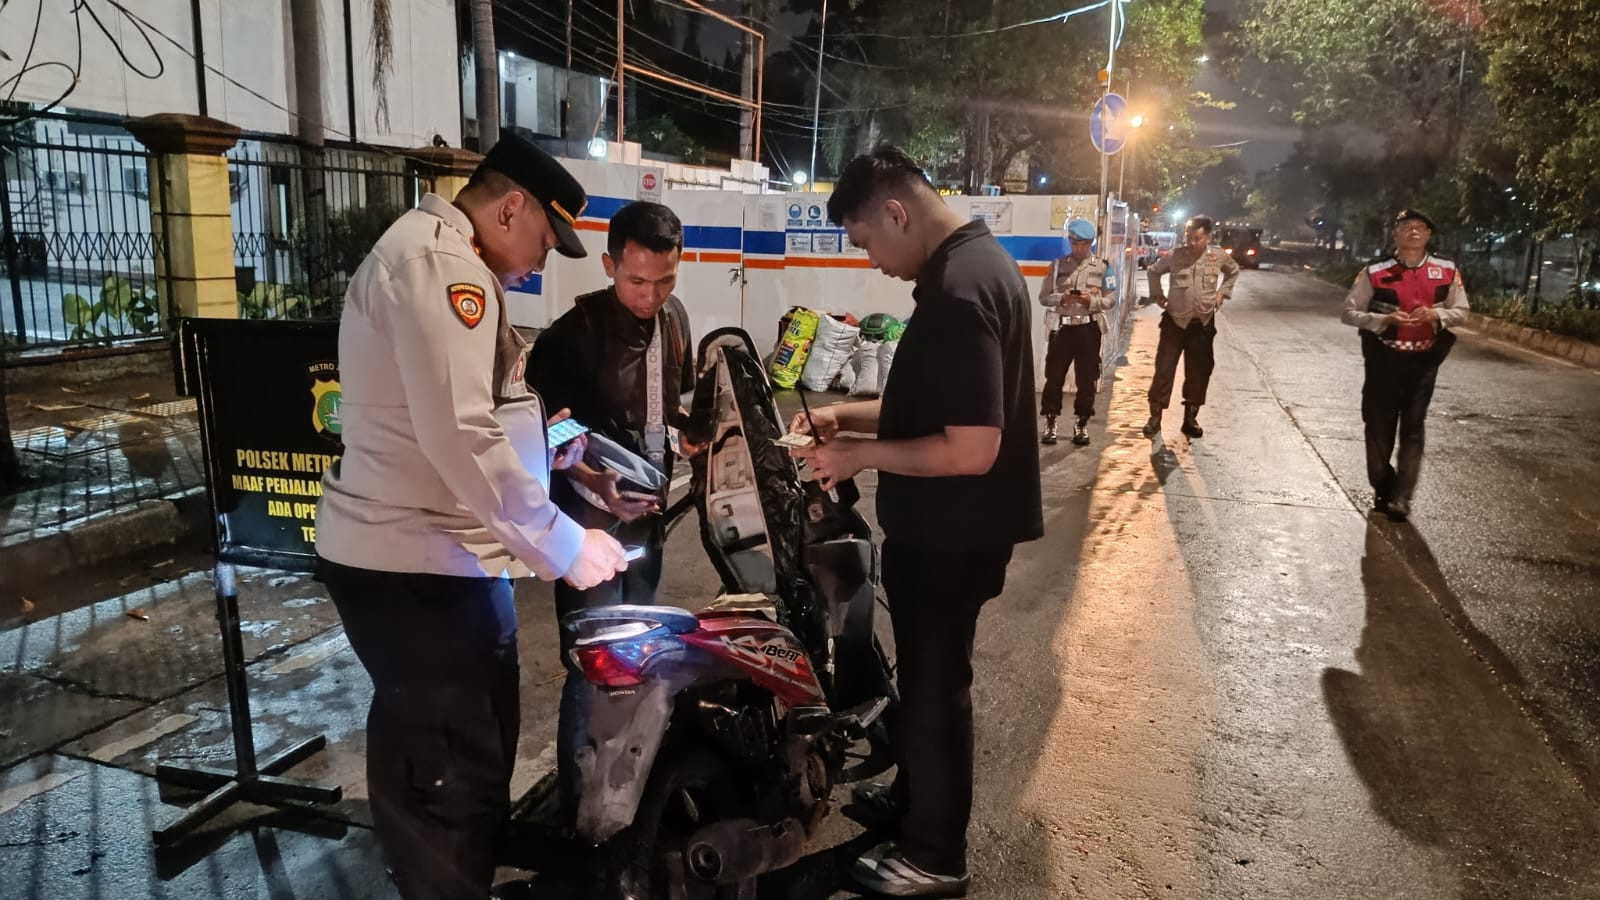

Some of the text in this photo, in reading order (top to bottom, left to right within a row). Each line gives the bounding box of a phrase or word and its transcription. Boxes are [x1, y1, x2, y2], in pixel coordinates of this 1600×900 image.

[309, 363, 335, 372] METRO
[236, 449, 290, 471] POLSEK
[232, 475, 263, 492] MAAF
[268, 501, 293, 517] ADA
